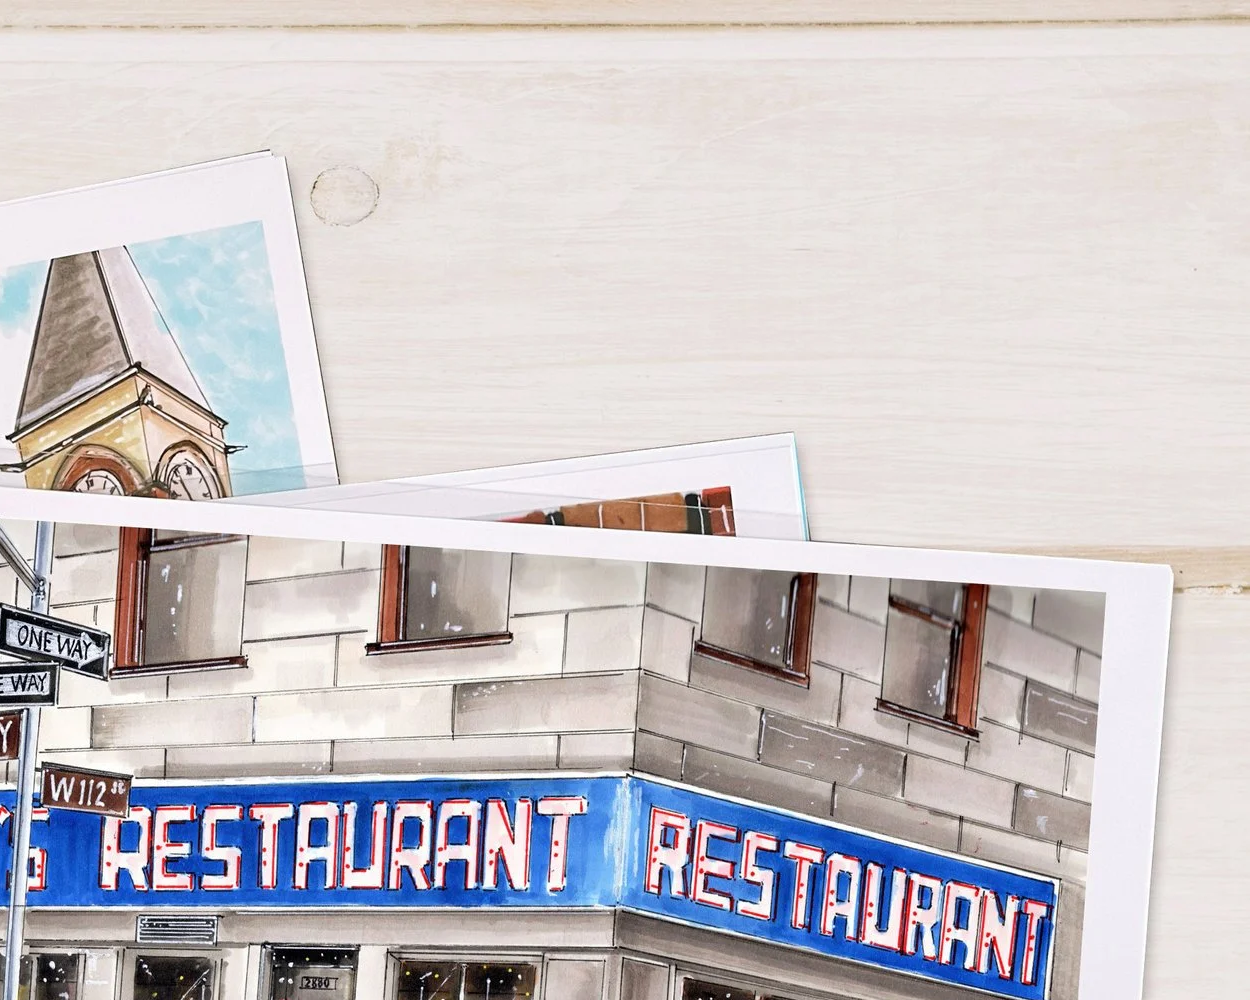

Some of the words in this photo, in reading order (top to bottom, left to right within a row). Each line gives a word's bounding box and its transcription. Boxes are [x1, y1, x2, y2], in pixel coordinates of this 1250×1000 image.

[17, 624, 53, 651] ONE
[57, 634, 93, 661] WAY
[11, 673, 48, 692] WAY
[50, 773, 75, 802] W
[79, 778, 108, 807] 112
[99, 795, 588, 892] RESTAURANT
[643, 804, 1053, 986] RESTAURANT
[304, 977, 331, 988] 2880
